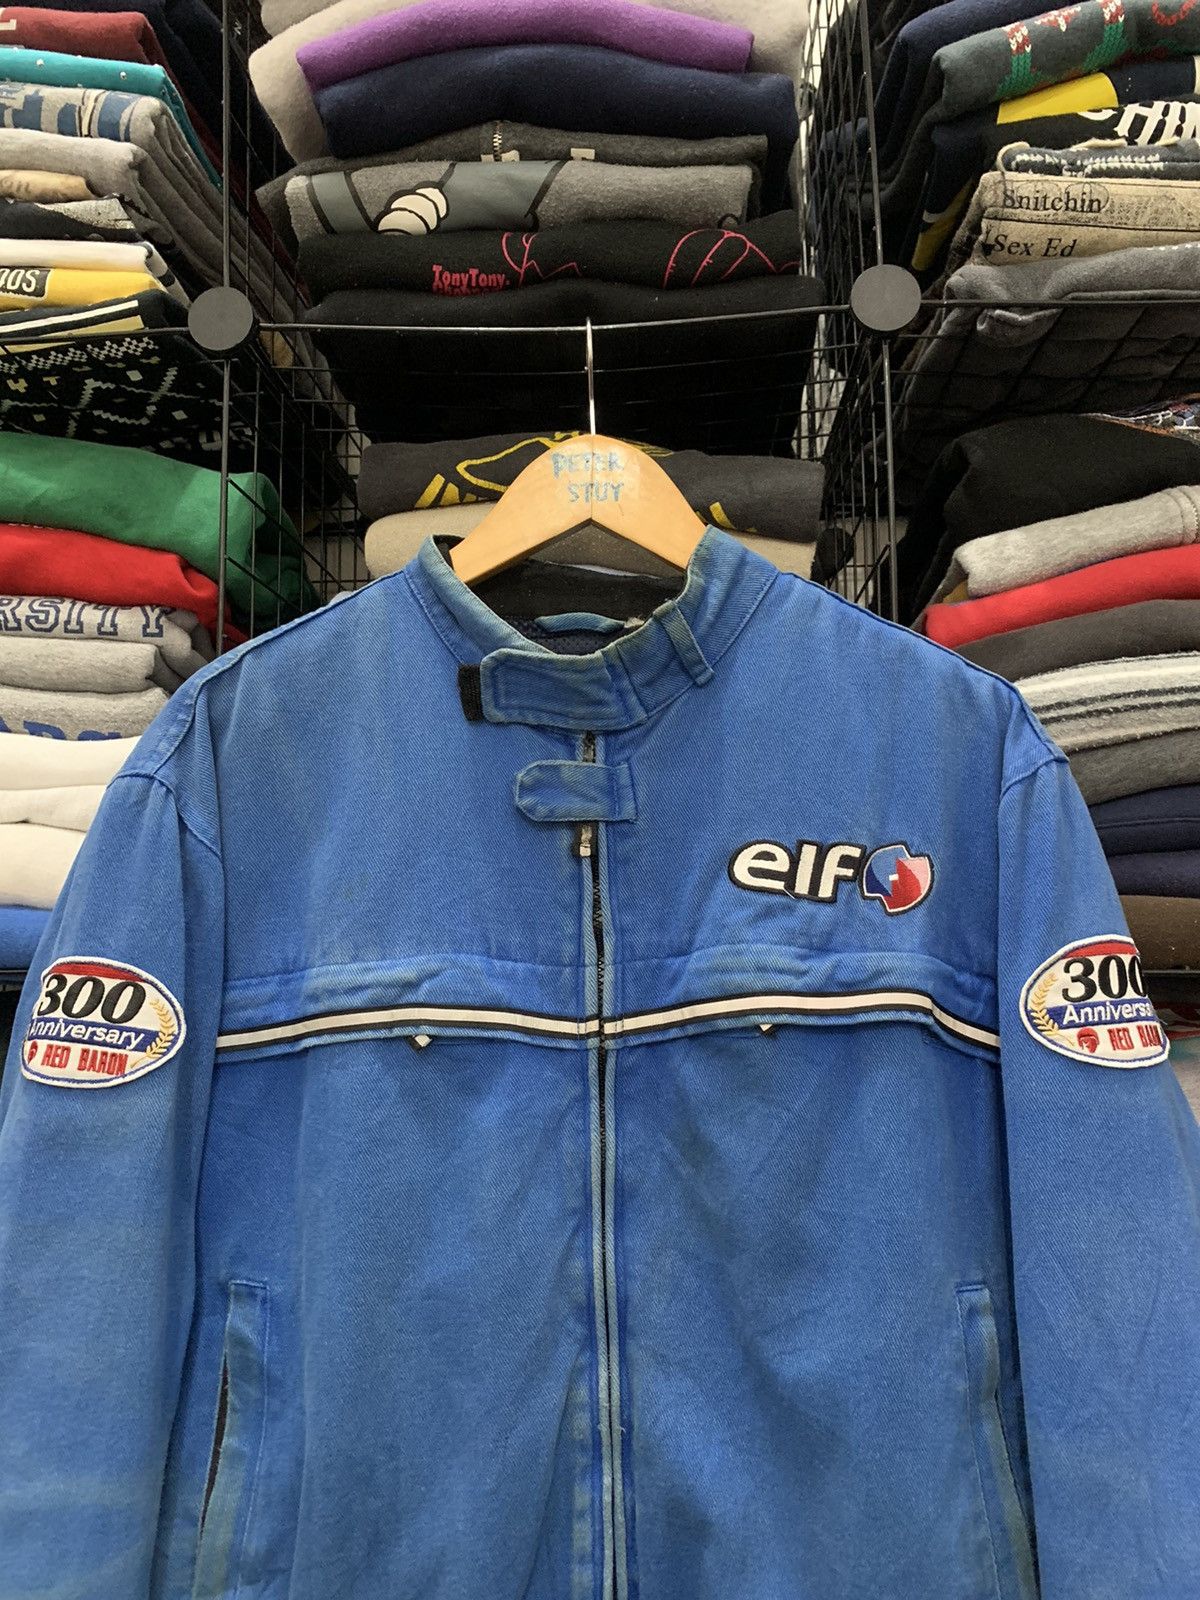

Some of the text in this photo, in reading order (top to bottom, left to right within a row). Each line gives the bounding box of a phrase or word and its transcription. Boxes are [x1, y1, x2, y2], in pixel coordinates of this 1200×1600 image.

[1002, 188, 1101, 214] Snitchin
[993, 233, 1078, 258] Sex Ed
[568, 482, 625, 503] STUY
[731, 841, 864, 900] elf
[37, 973, 147, 1024] 300
[1107, 1026, 1135, 1051] RED
[41, 1044, 129, 1076] RED BARON
